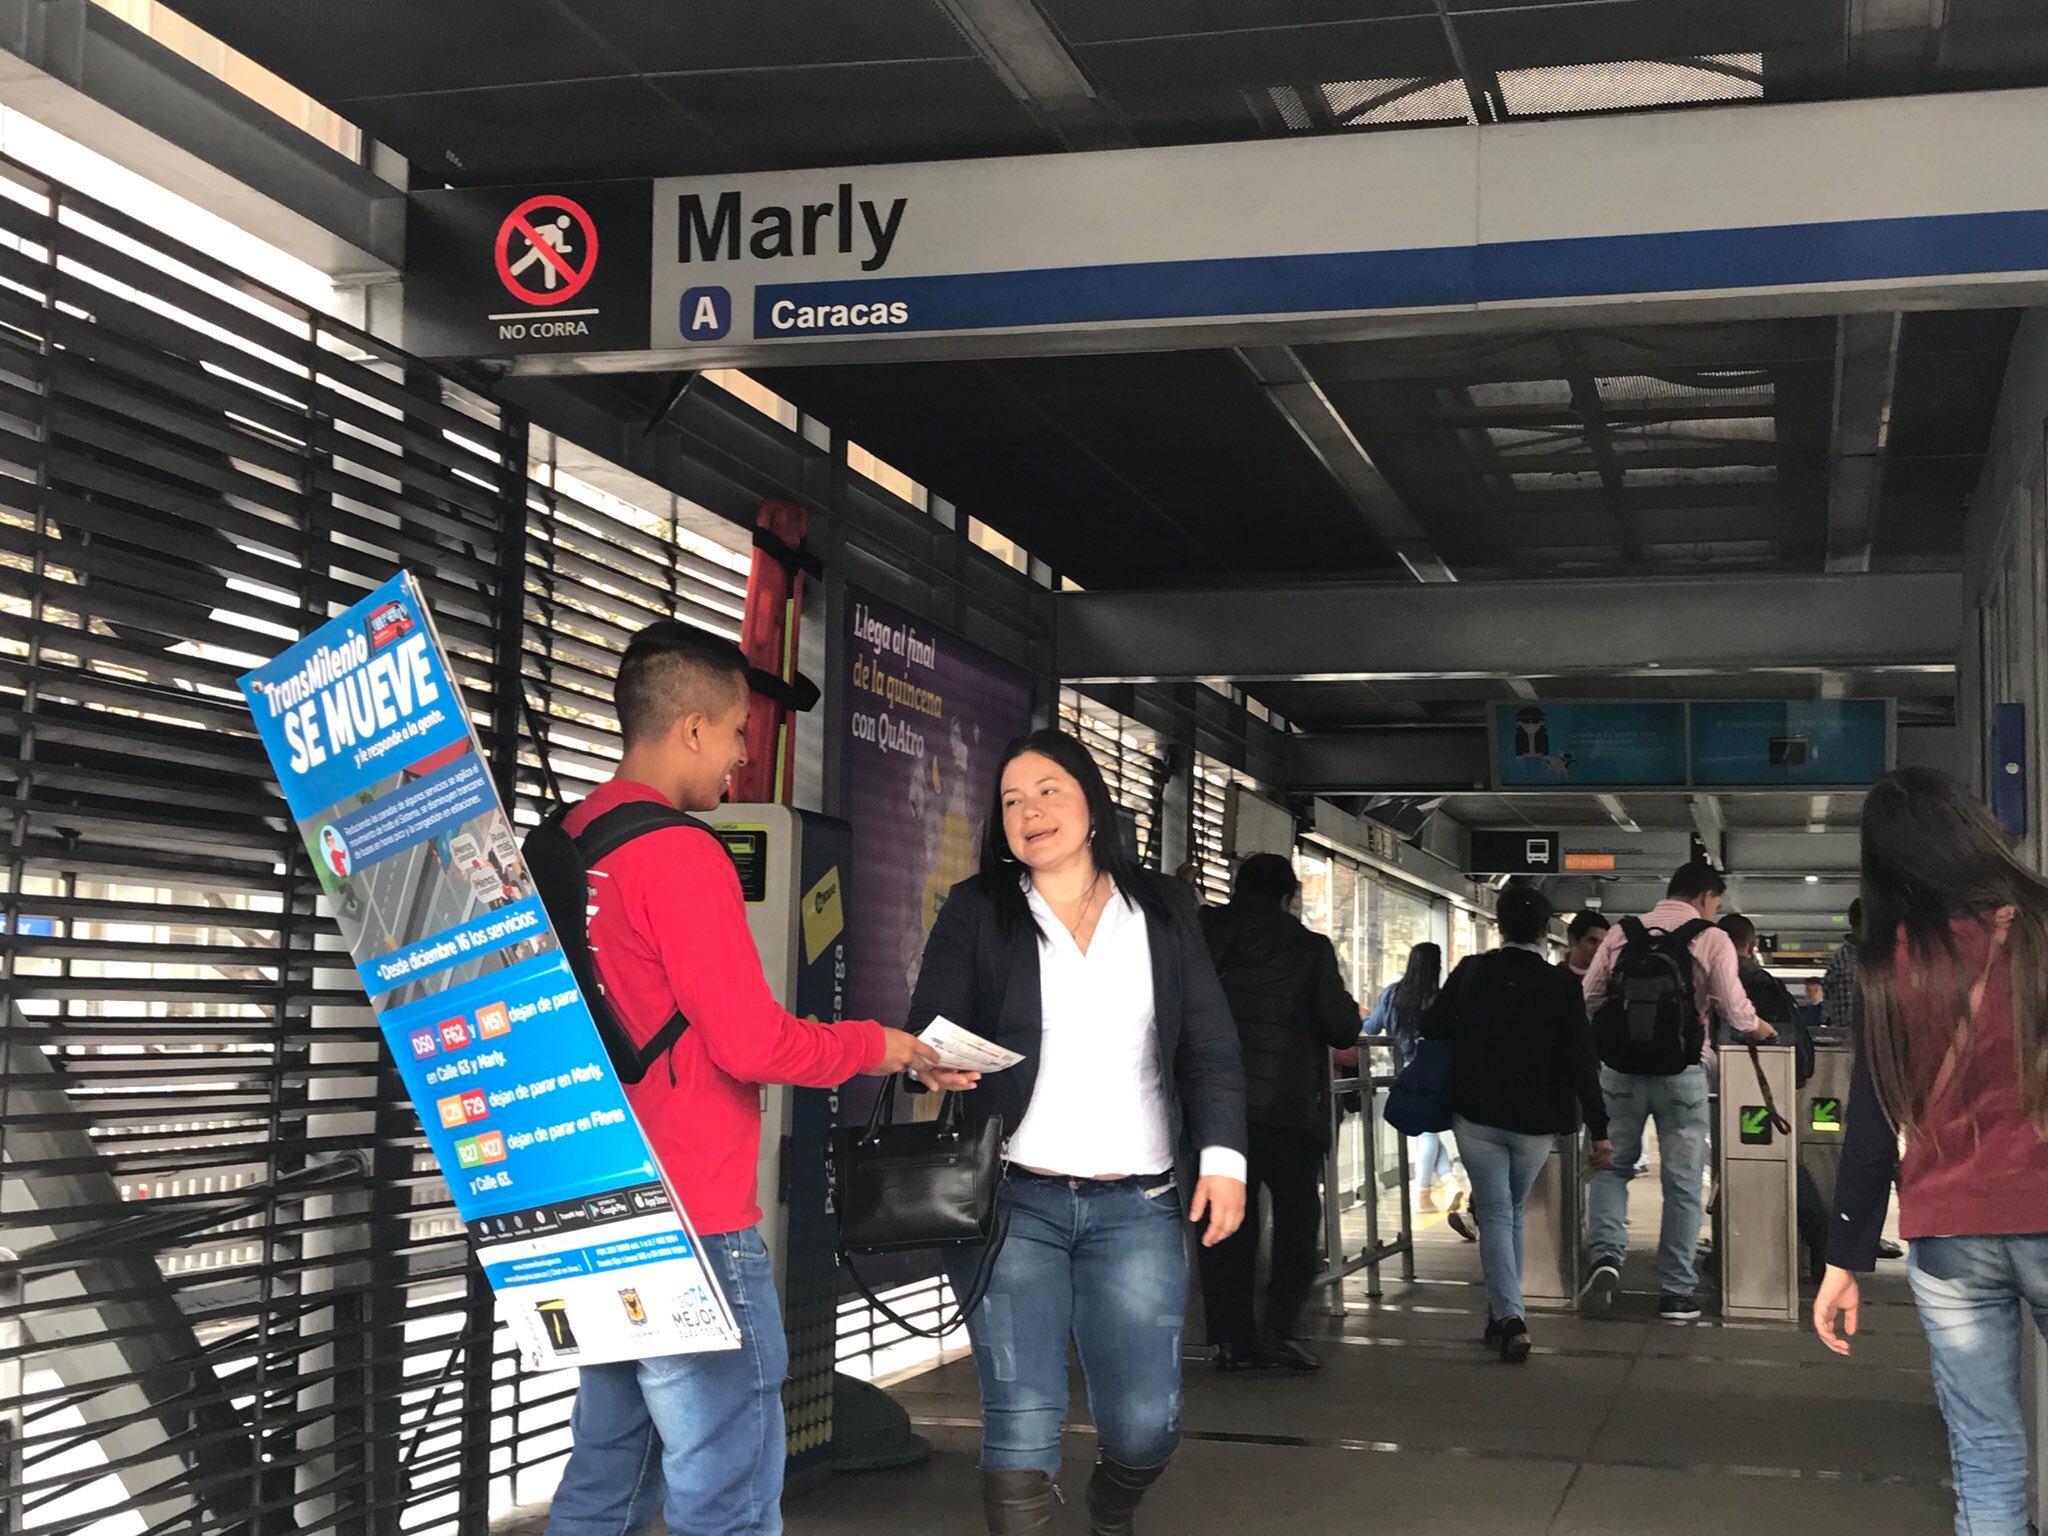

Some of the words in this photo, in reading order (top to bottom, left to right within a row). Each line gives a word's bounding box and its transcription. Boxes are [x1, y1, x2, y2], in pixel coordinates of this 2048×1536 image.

[677, 183, 908, 271] Marly
[499, 324, 526, 340] NO
[530, 321, 589, 338] CORRA
[692, 296, 719, 331] A
[771, 299, 909, 330] Caracas
[854, 602, 891, 655] Llega
[892, 624, 906, 657] al
[906, 627, 936, 670] final
[264, 629, 368, 717] TransMilenio
[853, 653, 870, 690] de
[871, 658, 885, 696] la
[886, 672, 942, 719] quincena
[285, 699, 327, 774] SE
[321, 632, 439, 755] MUEVE
[353, 754, 362, 770] y
[367, 729, 404, 758] responde
[401, 728, 410, 740] a
[406, 721, 419, 736] la
[852, 711, 876, 742] con
[878, 713, 925, 758] QuAtro
[379, 958, 410, 980] Desde
[409, 941, 458, 970] diciembre
[454, 934, 472, 951] 16
[469, 930, 488, 947] los
[411, 1034, 435, 1055] D50
[442, 1024, 466, 1045] F62
[467, 1025, 476, 1038] y
[508, 1003, 537, 1023] dejan
[537, 996, 553, 1013] de
[551, 989, 579, 1013] parar
[426, 1073, 437, 1085] en
[436, 1065, 458, 1082] Calle
[457, 1059, 470, 1076] 63
[470, 1060, 478, 1075] y
[463, 1096, 486, 1117] F29
[489, 1089, 516, 1108] dejan
[515, 1083, 530, 1100] de
[528, 1077, 557, 1099] parar
[557, 1073, 572, 1088] en
[571, 1063, 604, 1083] Marly.
[507, 1132, 535, 1150] dejan
[534, 1126, 549, 1143] de
[548, 1120, 577, 1142] parar
[576, 1116, 591, 1131] en
[589, 1108, 626, 1128] Flores
[468, 1180, 477, 1195] y
[476, 1175, 498, 1193] Calle
